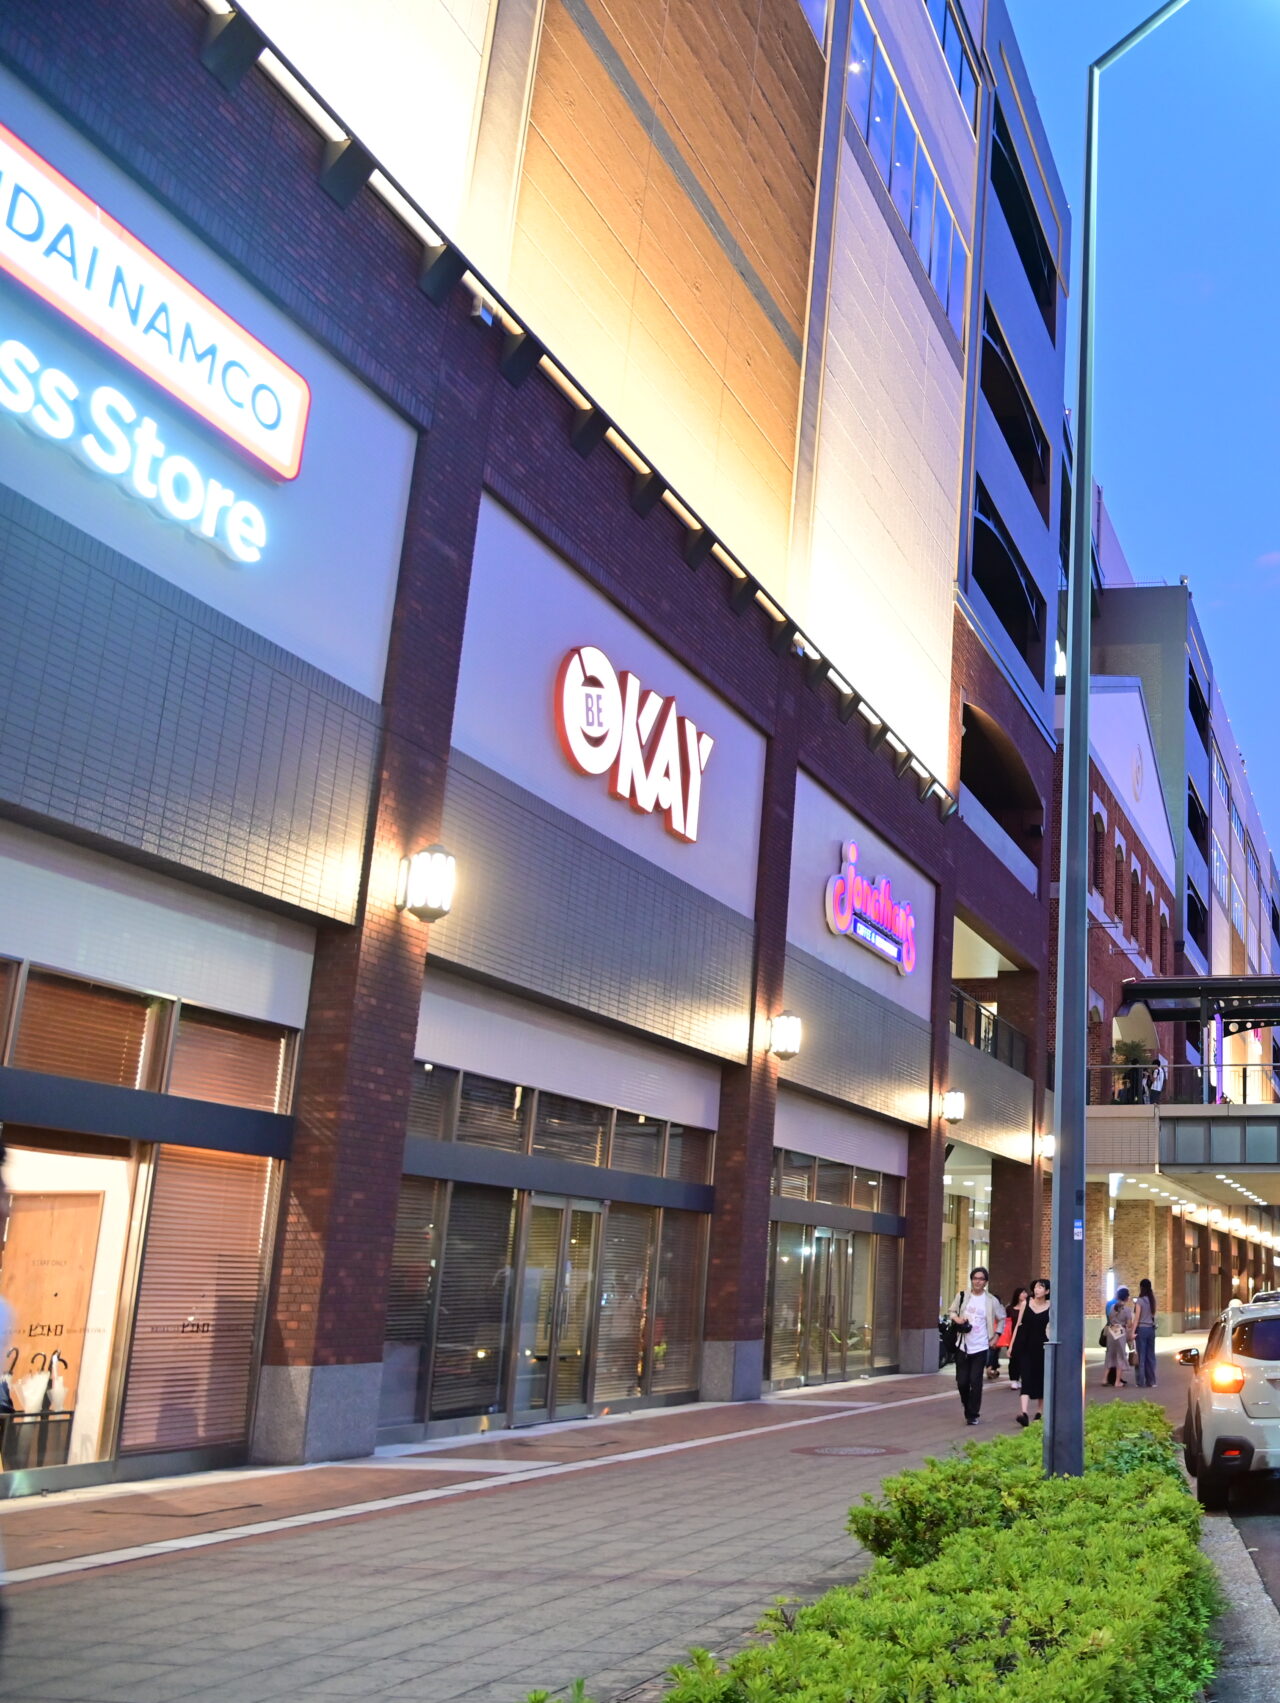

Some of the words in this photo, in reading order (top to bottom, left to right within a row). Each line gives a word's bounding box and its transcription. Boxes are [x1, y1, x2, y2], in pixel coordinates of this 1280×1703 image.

[109, 265, 282, 431] NAMCO
[82, 386, 267, 563] Store
[555, 646, 714, 842] OKAY
[585, 693, 604, 727] BE
[28, 1323, 64, 1337] ピエトロ
